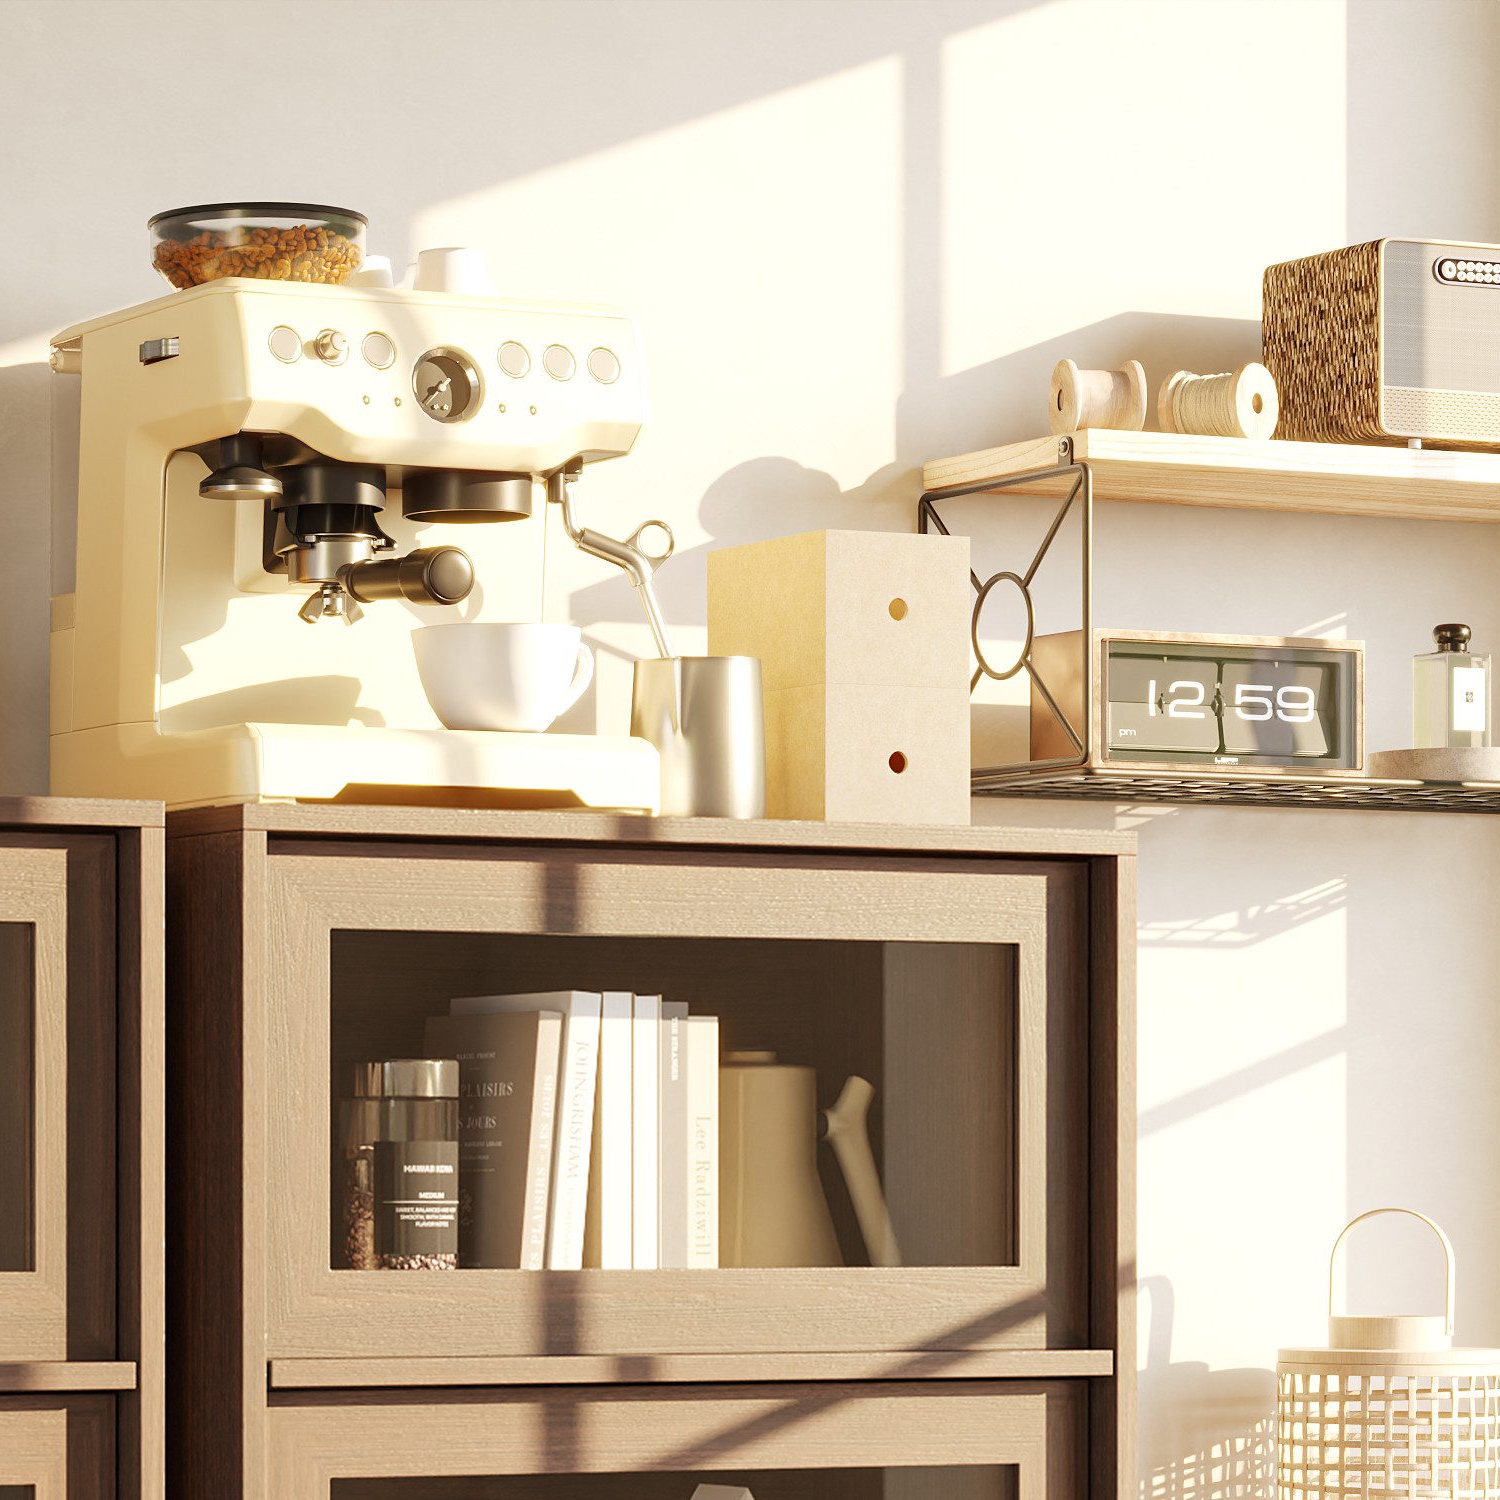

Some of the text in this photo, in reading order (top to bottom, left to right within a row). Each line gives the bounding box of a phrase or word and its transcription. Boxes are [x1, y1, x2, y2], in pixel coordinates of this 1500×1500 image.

[1148, 679, 1315, 723] 12 59
[1119, 728, 1137, 738] pm
[695, 1116, 711, 1256] Lee Radziwill
